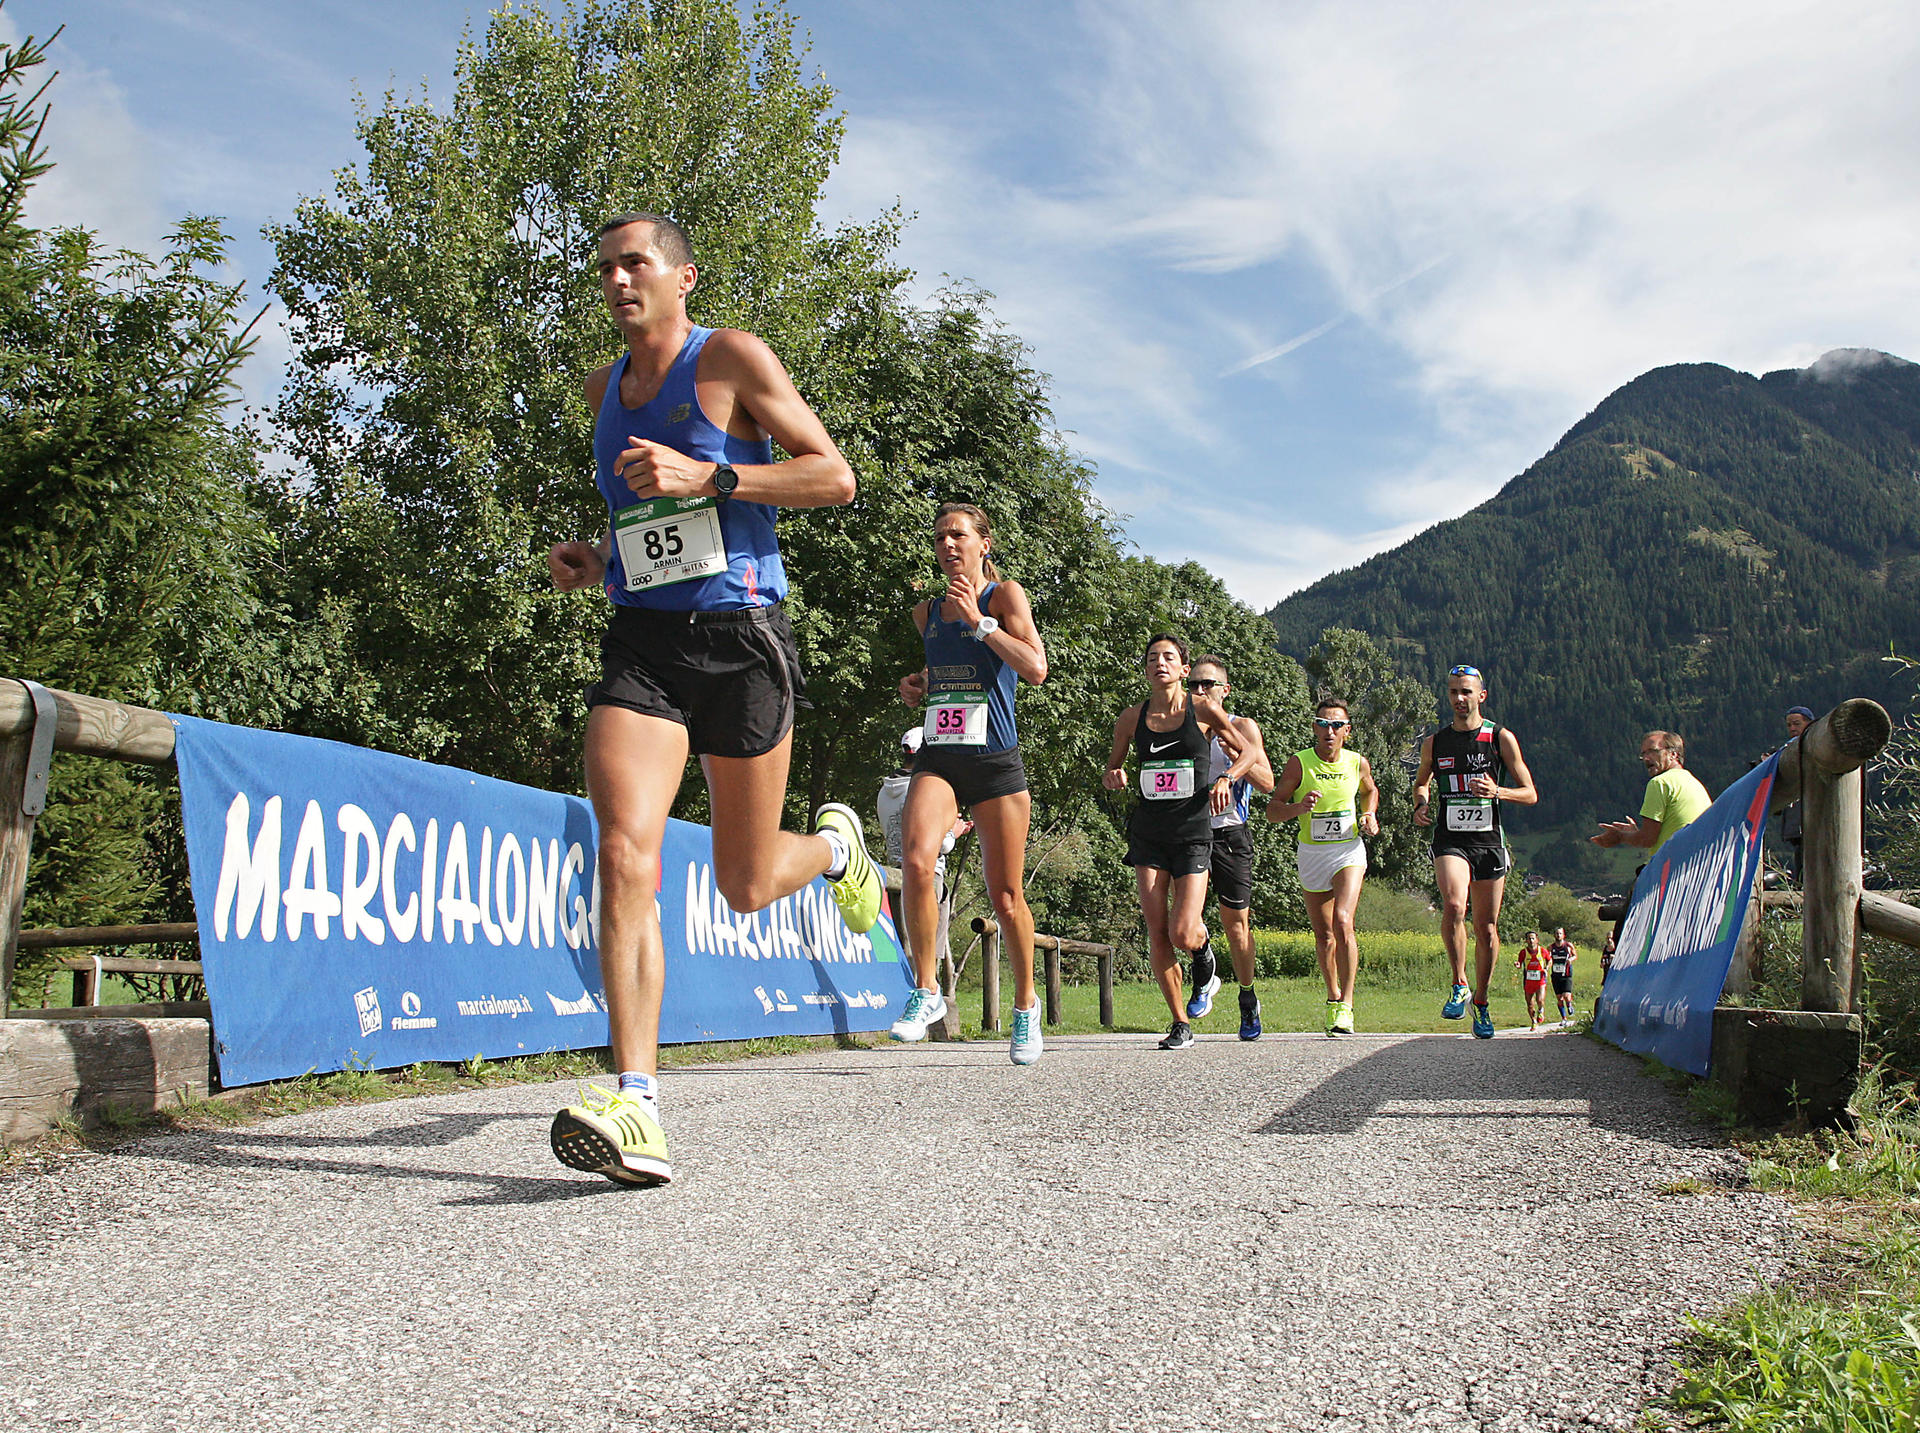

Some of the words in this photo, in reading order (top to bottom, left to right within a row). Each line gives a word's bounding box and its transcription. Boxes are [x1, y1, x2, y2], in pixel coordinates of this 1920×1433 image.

[643, 525, 683, 560] 85
[653, 556, 682, 569] ARMIN
[690, 561, 709, 571] ITAS
[631, 574, 653, 586] coop
[938, 709, 963, 729] 35
[1156, 773, 1176, 787] 37
[1457, 809, 1483, 821] 372
[1325, 820, 1341, 832] 73
[456, 994, 534, 1018] marcialonga.it
[391, 1016, 437, 1030] fiemme
